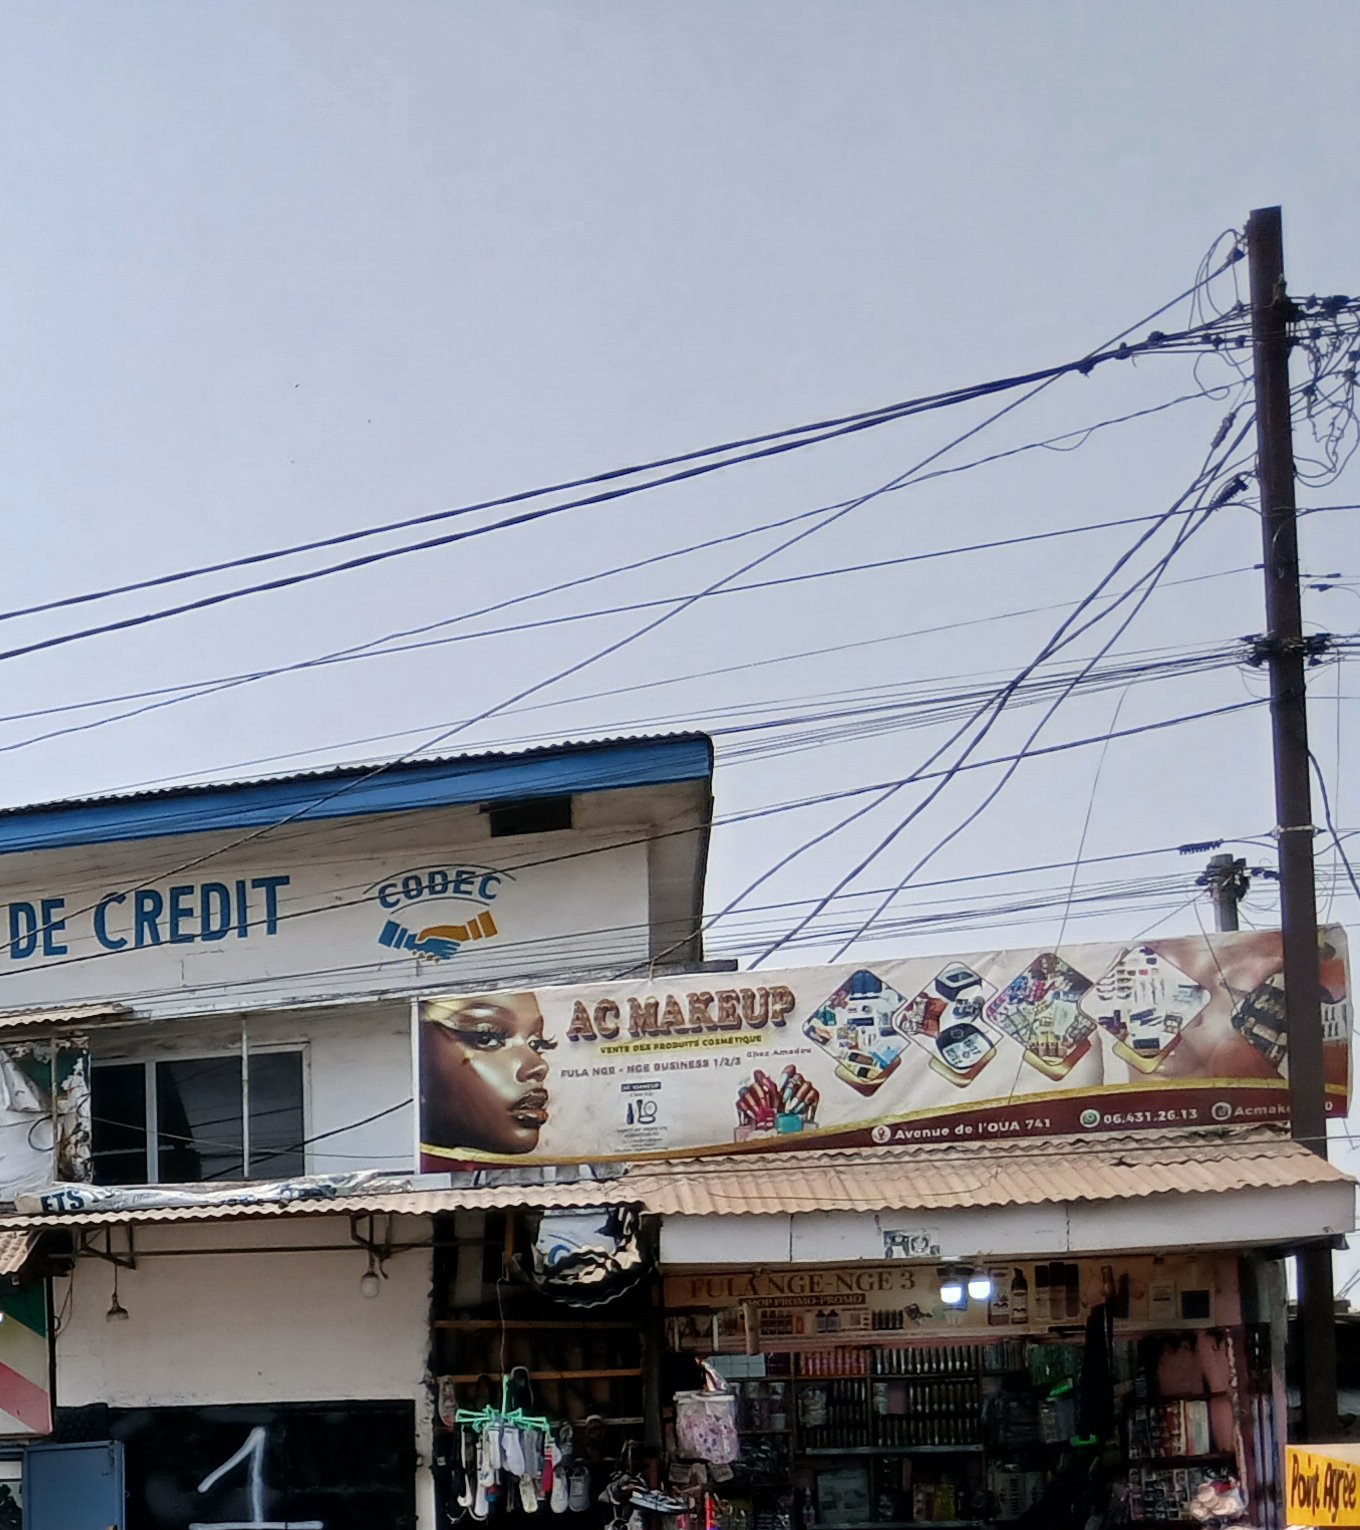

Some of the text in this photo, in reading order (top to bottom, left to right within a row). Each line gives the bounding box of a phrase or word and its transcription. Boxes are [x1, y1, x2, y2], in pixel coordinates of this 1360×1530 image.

[379, 868, 502, 909] CODEC
[8, 897, 68, 960] DE
[92, 874, 291, 951] CREDIT
[566, 985, 796, 1042] AC MAKEUP
[600, 1045, 630, 1055] VENTE
[633, 1043, 652, 1052] DES
[653, 1039, 700, 1050] PRODUITS
[654, 1058, 709, 1073] BUSINESS
[954, 1123, 973, 1136] de
[978, 1121, 1021, 1134] l'OUA
[1025, 1118, 1051, 1130] 741
[40, 1190, 85, 1212] ETS
[690, 1270, 916, 1299] FULA NGE-NGE 3
[1291, 1453, 1320, 1516] Point
